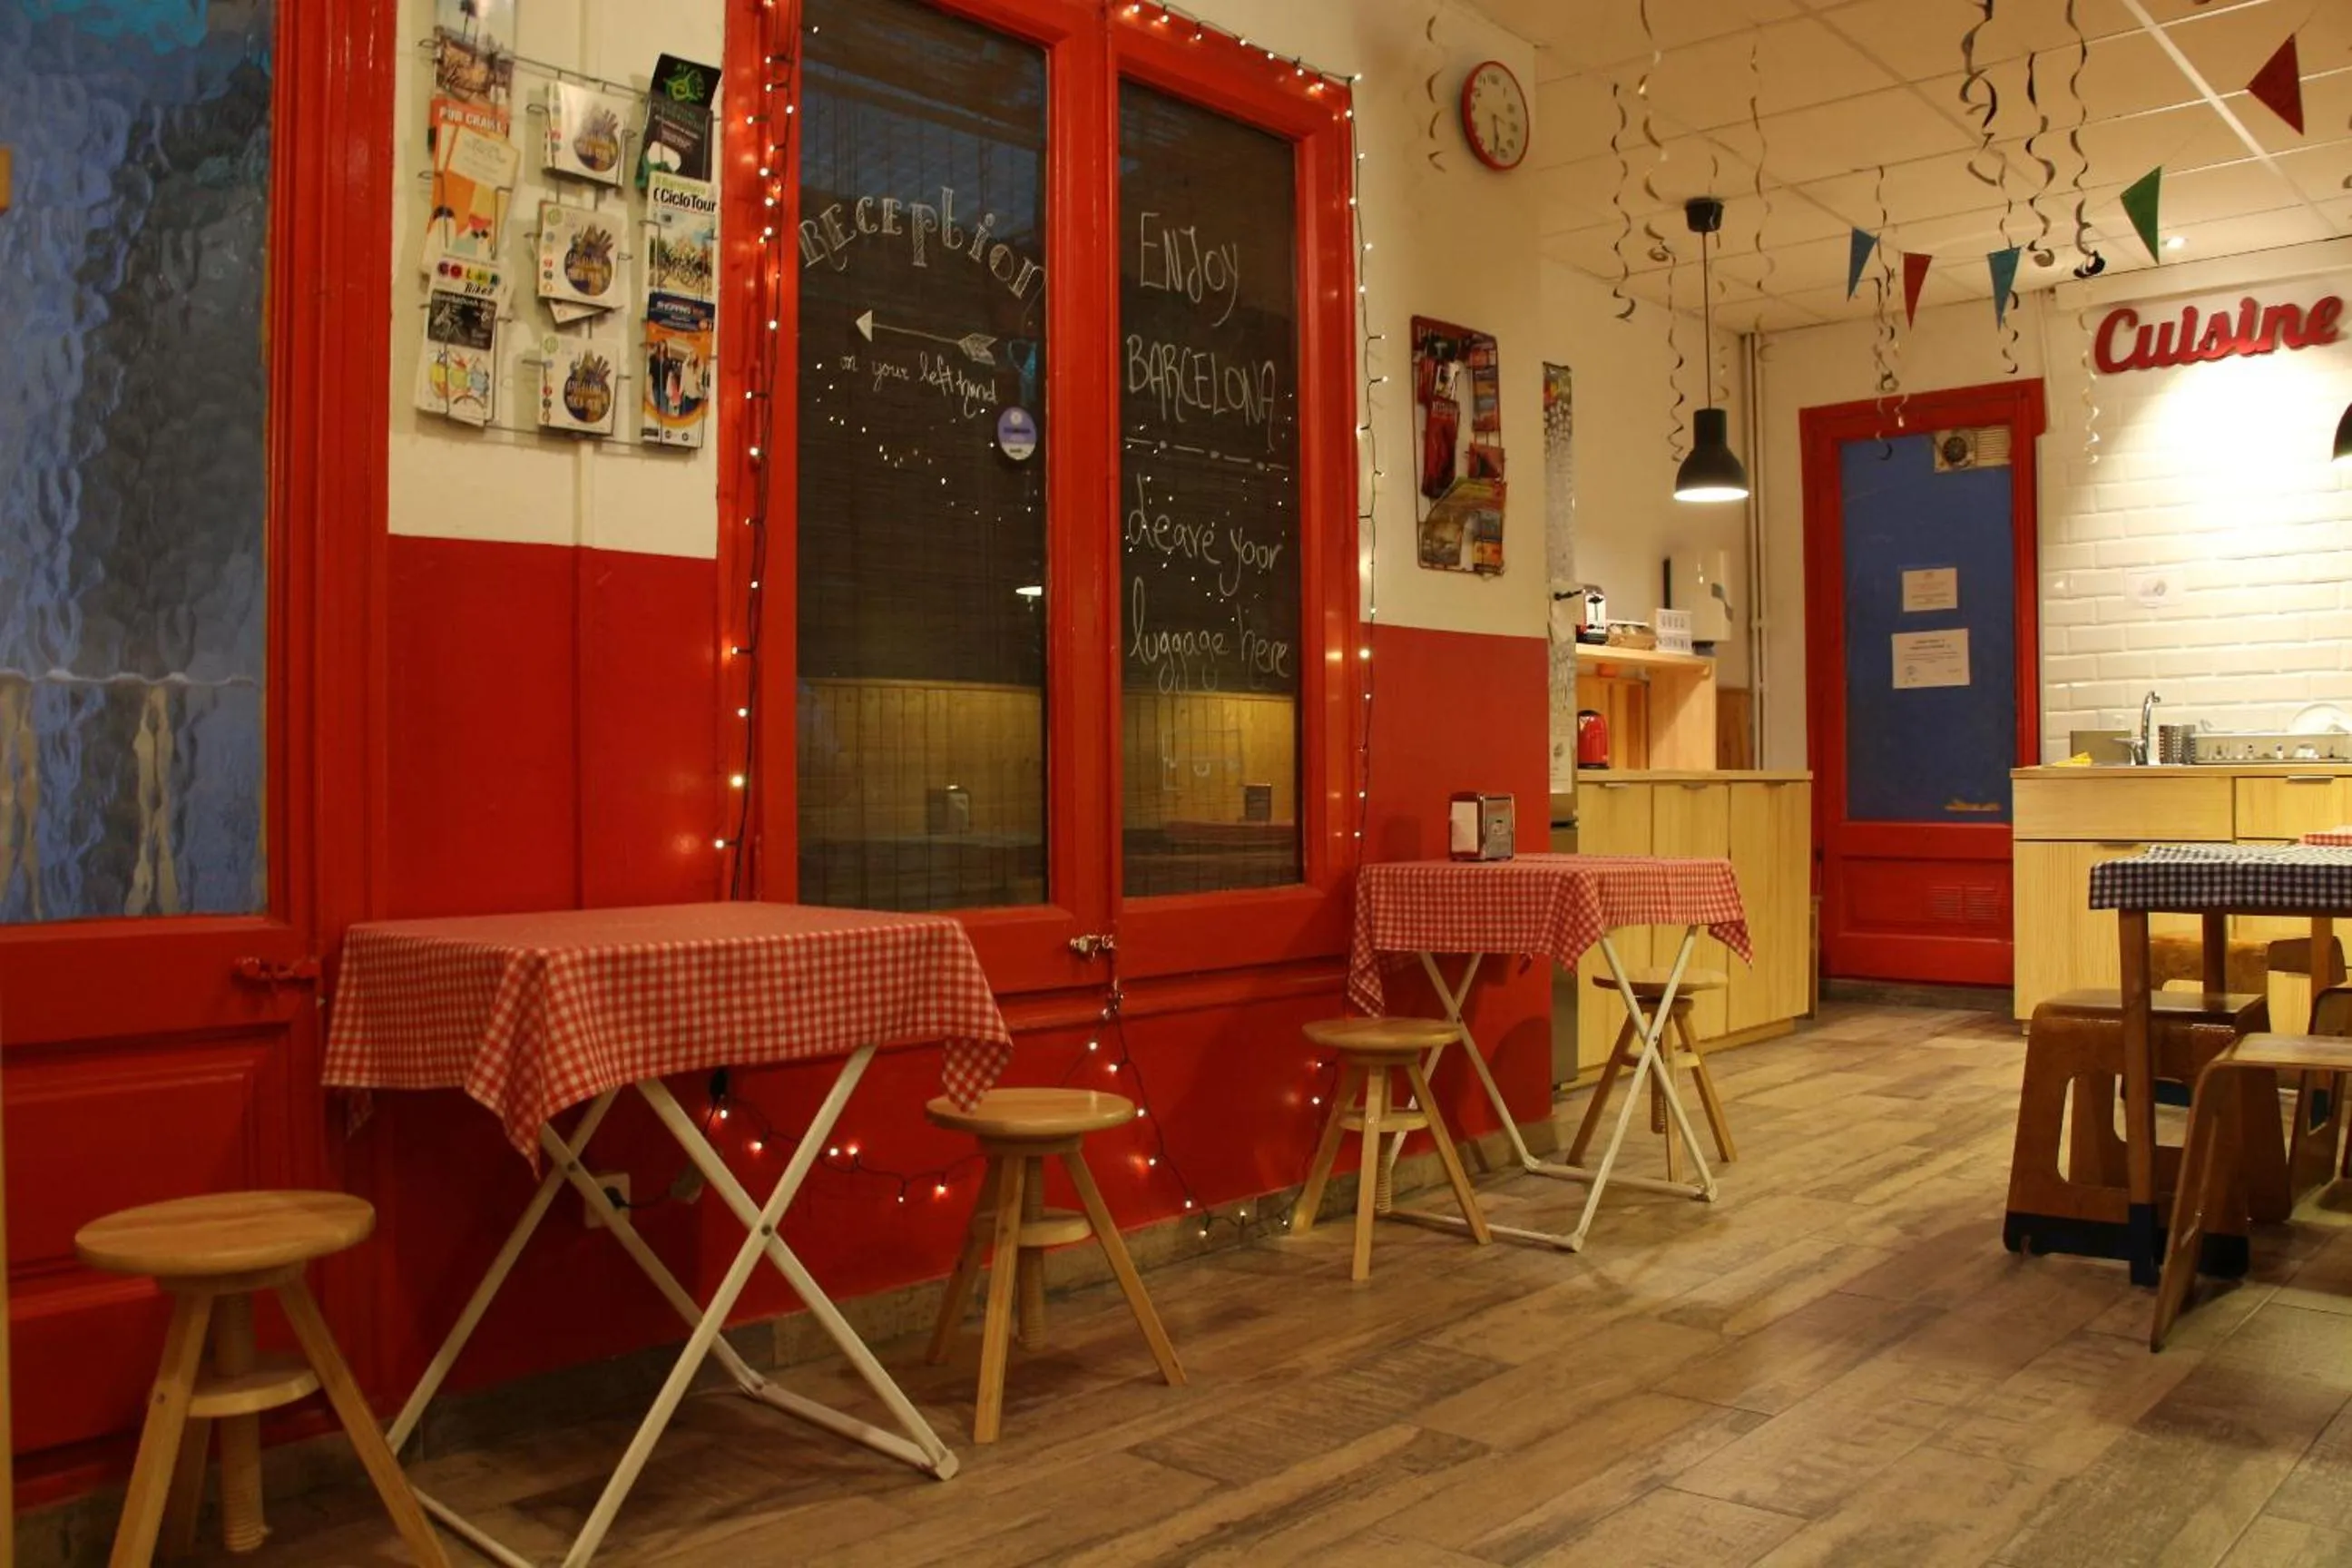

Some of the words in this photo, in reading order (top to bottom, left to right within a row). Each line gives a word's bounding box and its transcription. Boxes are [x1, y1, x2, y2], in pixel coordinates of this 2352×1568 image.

[2093, 295, 2345, 375] Cuisine
[839, 355, 858, 372] on
[871, 360, 909, 392] your
[919, 350, 954, 397] left
[956, 369, 999, 419] hand
[1126, 333, 1276, 452] BARCELONA
[1219, 526, 1285, 597] your
[1129, 575, 1230, 695] luggage
[1236, 602, 1290, 690] here
